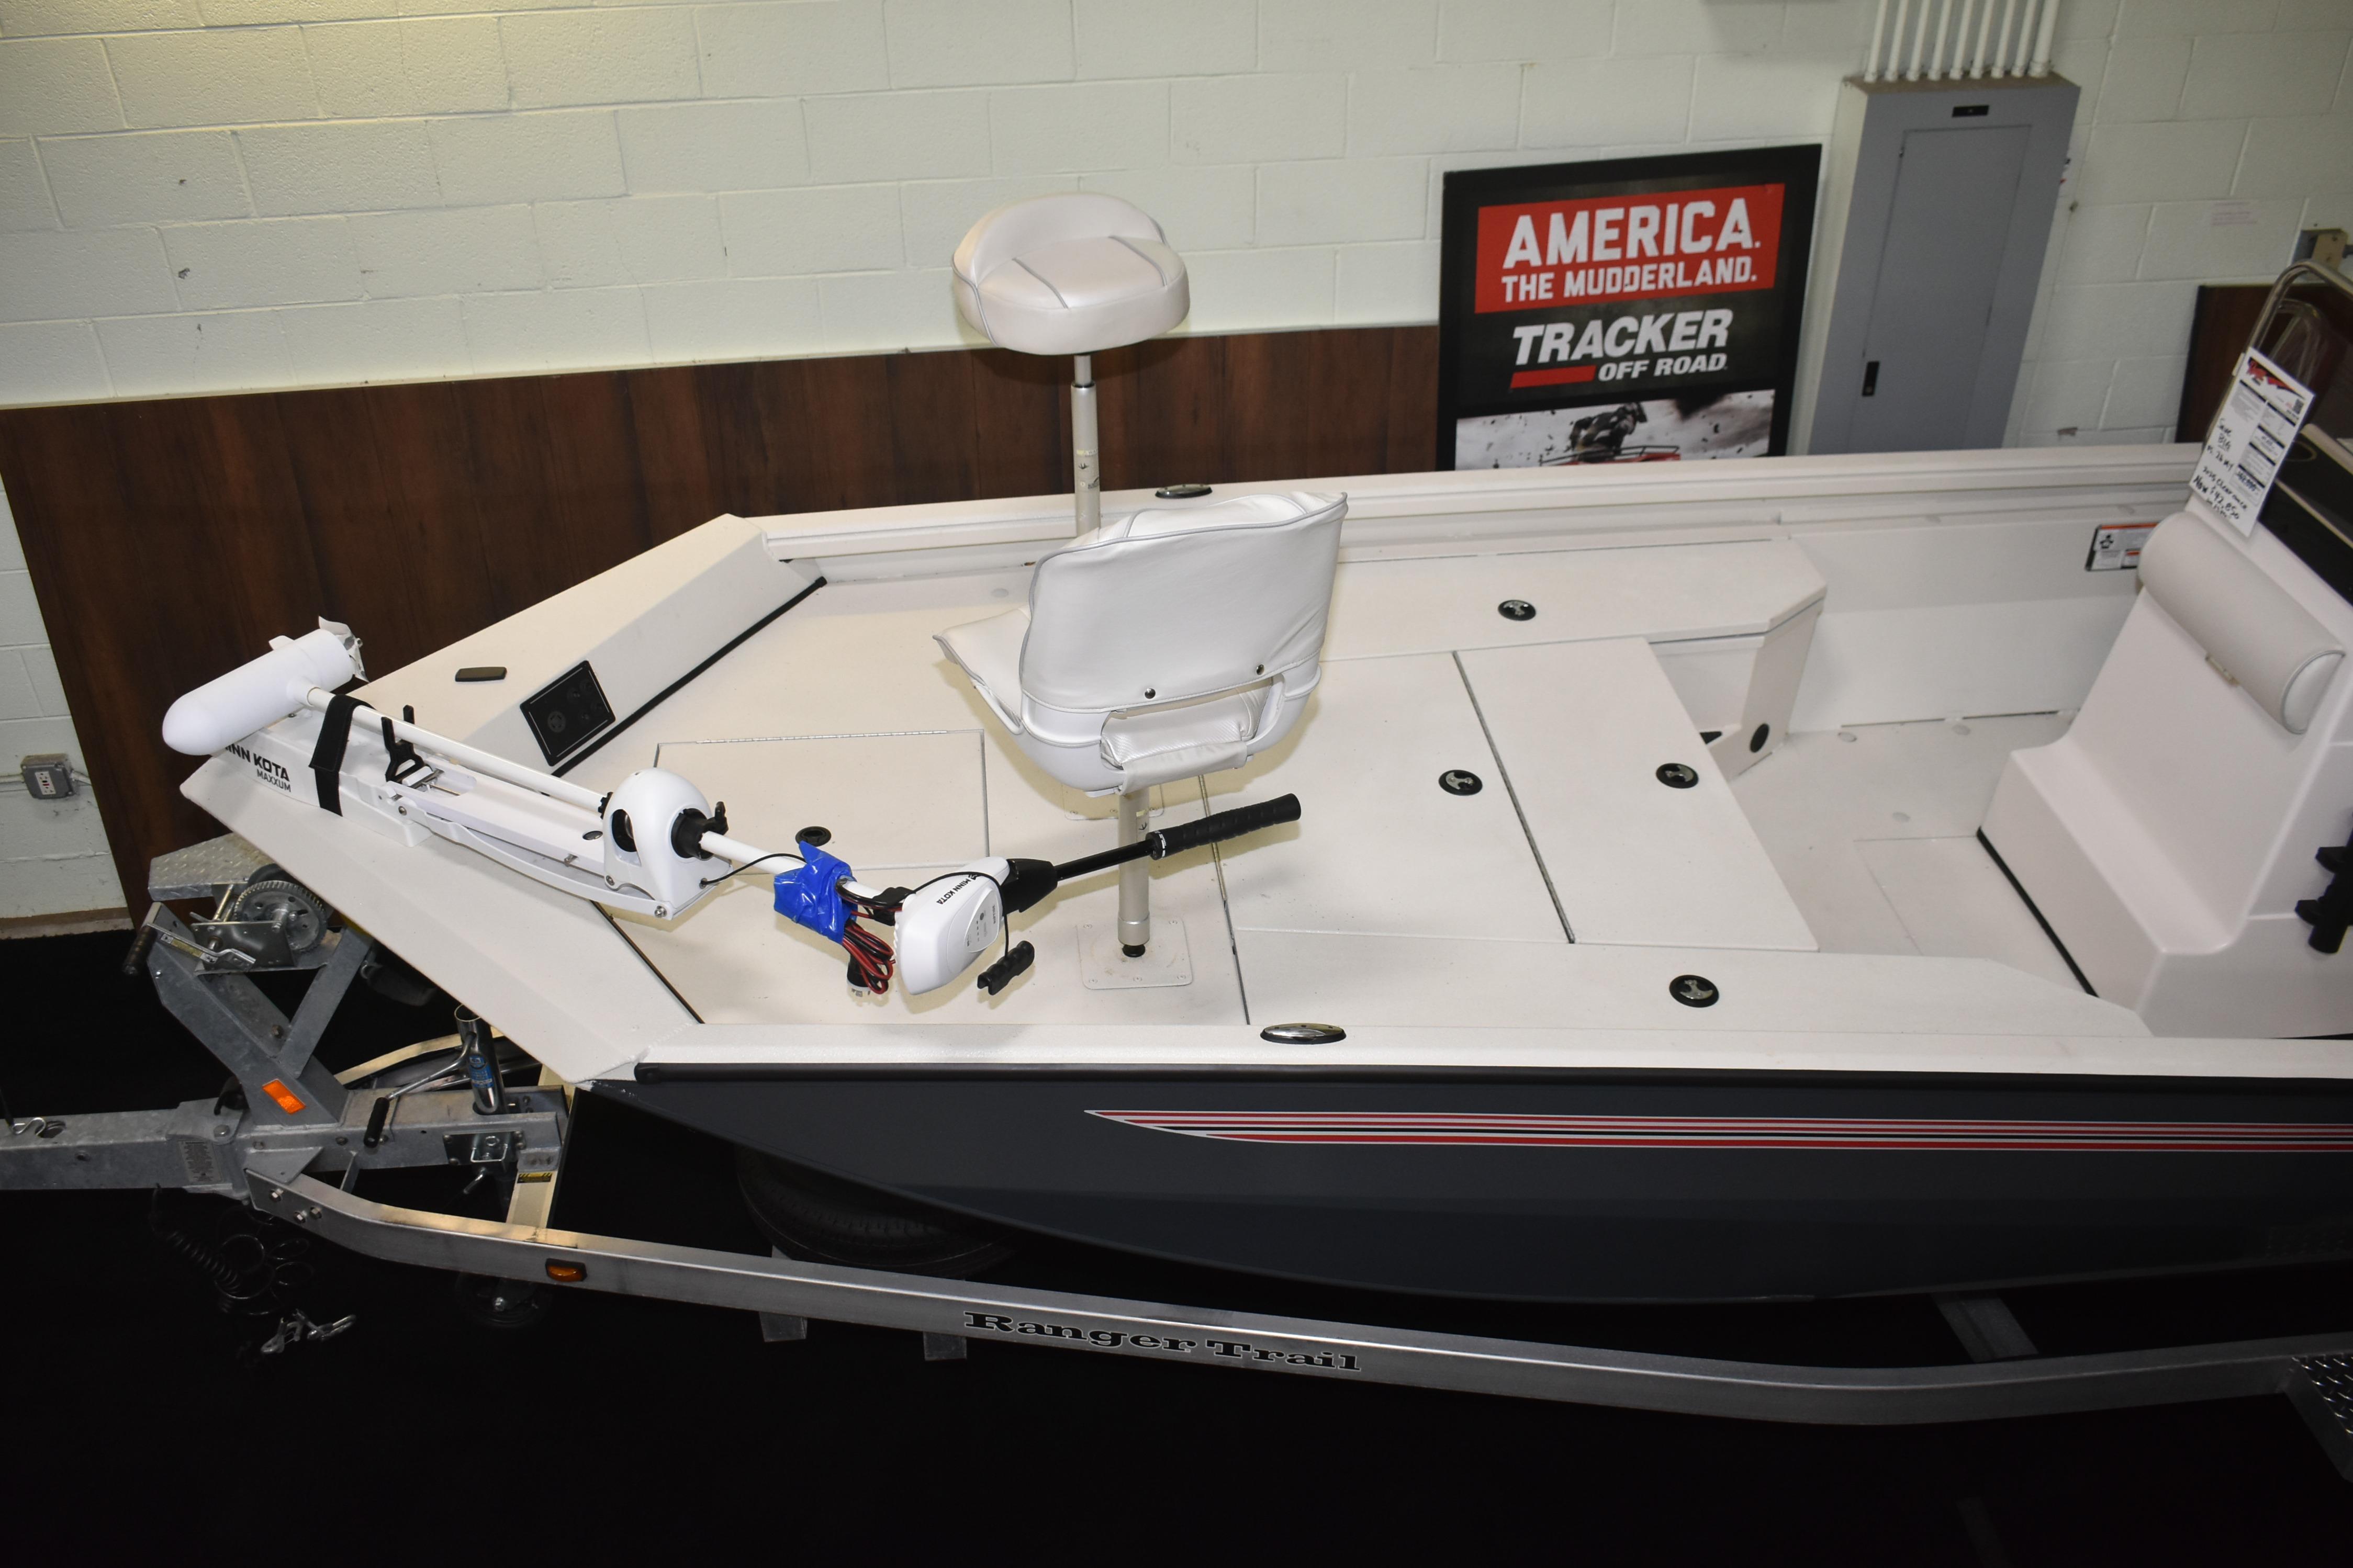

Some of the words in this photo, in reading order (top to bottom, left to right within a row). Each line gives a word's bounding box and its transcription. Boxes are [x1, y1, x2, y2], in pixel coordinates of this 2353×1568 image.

[1502, 197, 1761, 269] AMERICA.
[1502, 272, 1554, 303] THE
[1563, 255, 1757, 298] MUDDERLAND.
[1512, 309, 1734, 366] TRACKER
[1598, 359, 1649, 382] OFF
[1653, 353, 1728, 376] ROAD
[225, 743, 251, 763] INN
[253, 752, 290, 782] KOTA
[256, 768, 291, 793] MAXXUM
[936, 889, 956, 905] KOTA
[953, 878, 971, 892] MINN
[963, 1311, 1197, 1353] Ranger
[1205, 1339, 1361, 1371] Trail
